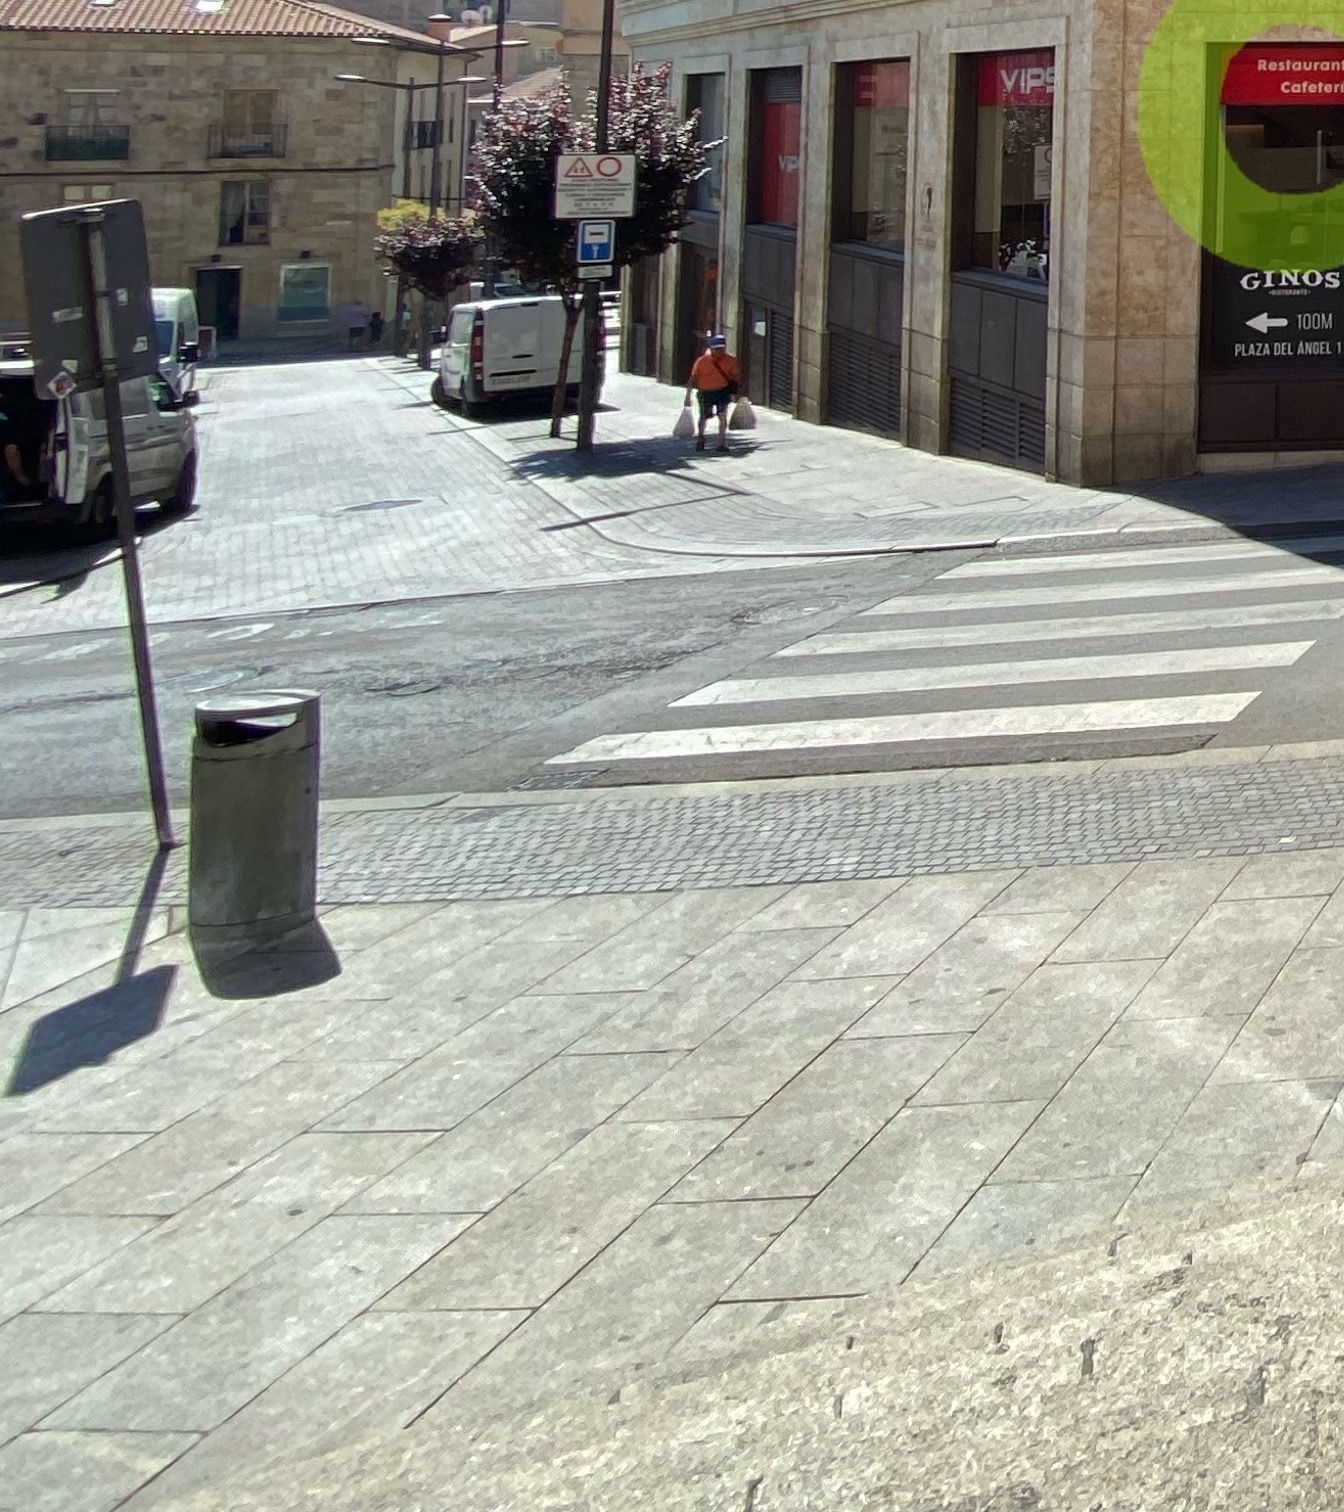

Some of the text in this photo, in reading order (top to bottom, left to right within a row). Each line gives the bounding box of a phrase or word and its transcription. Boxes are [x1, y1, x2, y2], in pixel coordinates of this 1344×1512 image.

[1240, 269, 1341, 290] GINOS
[1297, 313, 1333, 330] 100M
[1234, 343, 1271, 357] PLAZA
[1273, 342, 1294, 356] DEL
[1336, 341, 1342, 354] 1
